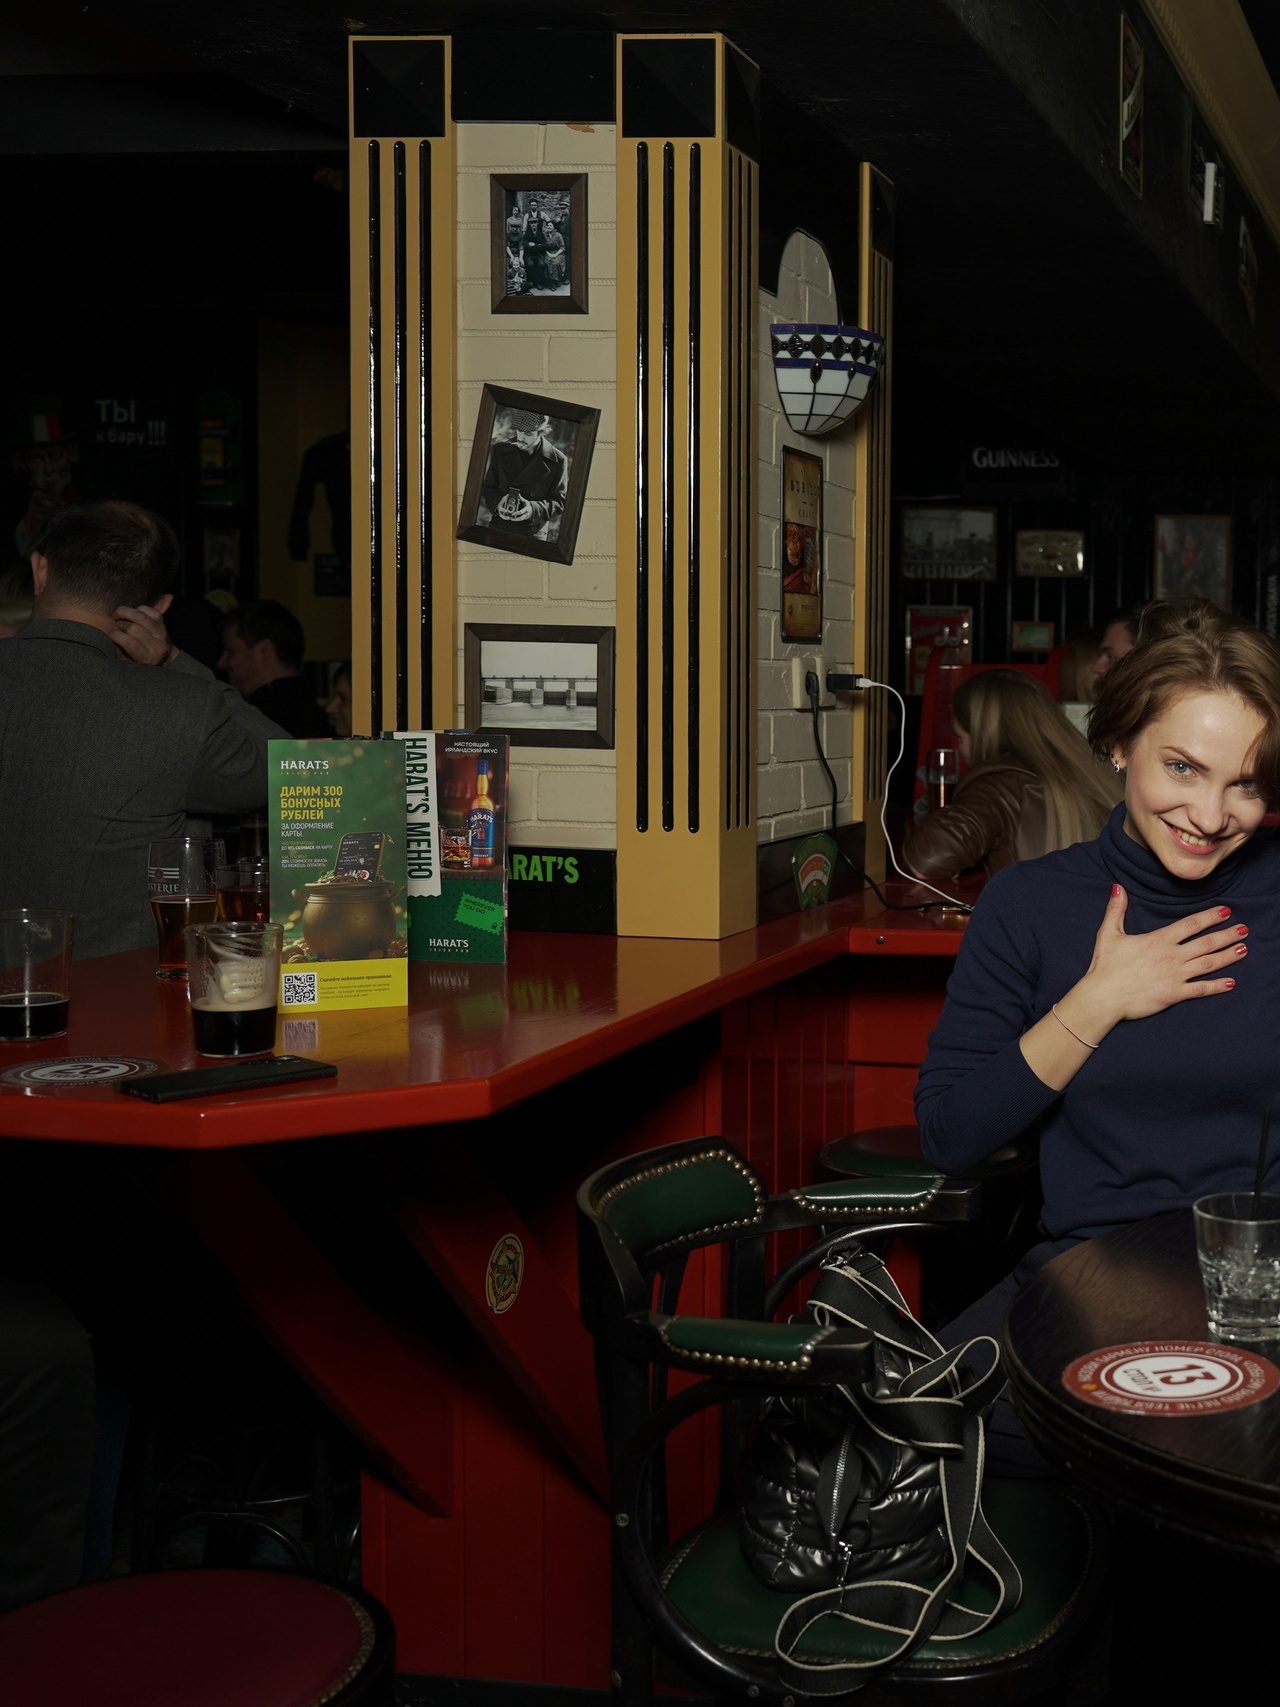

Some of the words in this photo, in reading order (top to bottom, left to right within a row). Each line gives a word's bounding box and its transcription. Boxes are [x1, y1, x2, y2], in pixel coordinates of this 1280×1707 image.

[94, 399, 137, 423] ТЫ
[95, 432, 106, 444] к
[972, 446, 1062, 469] GUINNESS
[405, 738, 430, 813] HARAT'S
[280, 785, 321, 798] ДАРИМ
[323, 785, 343, 796] 300
[280, 797, 341, 808] БОНУСНЫХ
[280, 807, 324, 820] РУБЛЕЙ
[281, 822, 290, 830] ЗА
[290, 822, 334, 830] ОФОРМЛЕНИЕ
[281, 830, 303, 838] КАРТЫ
[406, 822, 433, 880] МЕНЮ
[463, 903, 474, 911] YOU
[475, 907, 486, 915] GO
[464, 898, 496, 912] WHEREVER
[429, 938, 469, 948] HARAT'S
[52, 1064, 119, 1075] 26
[1152, 1364, 1218, 1386] 13
